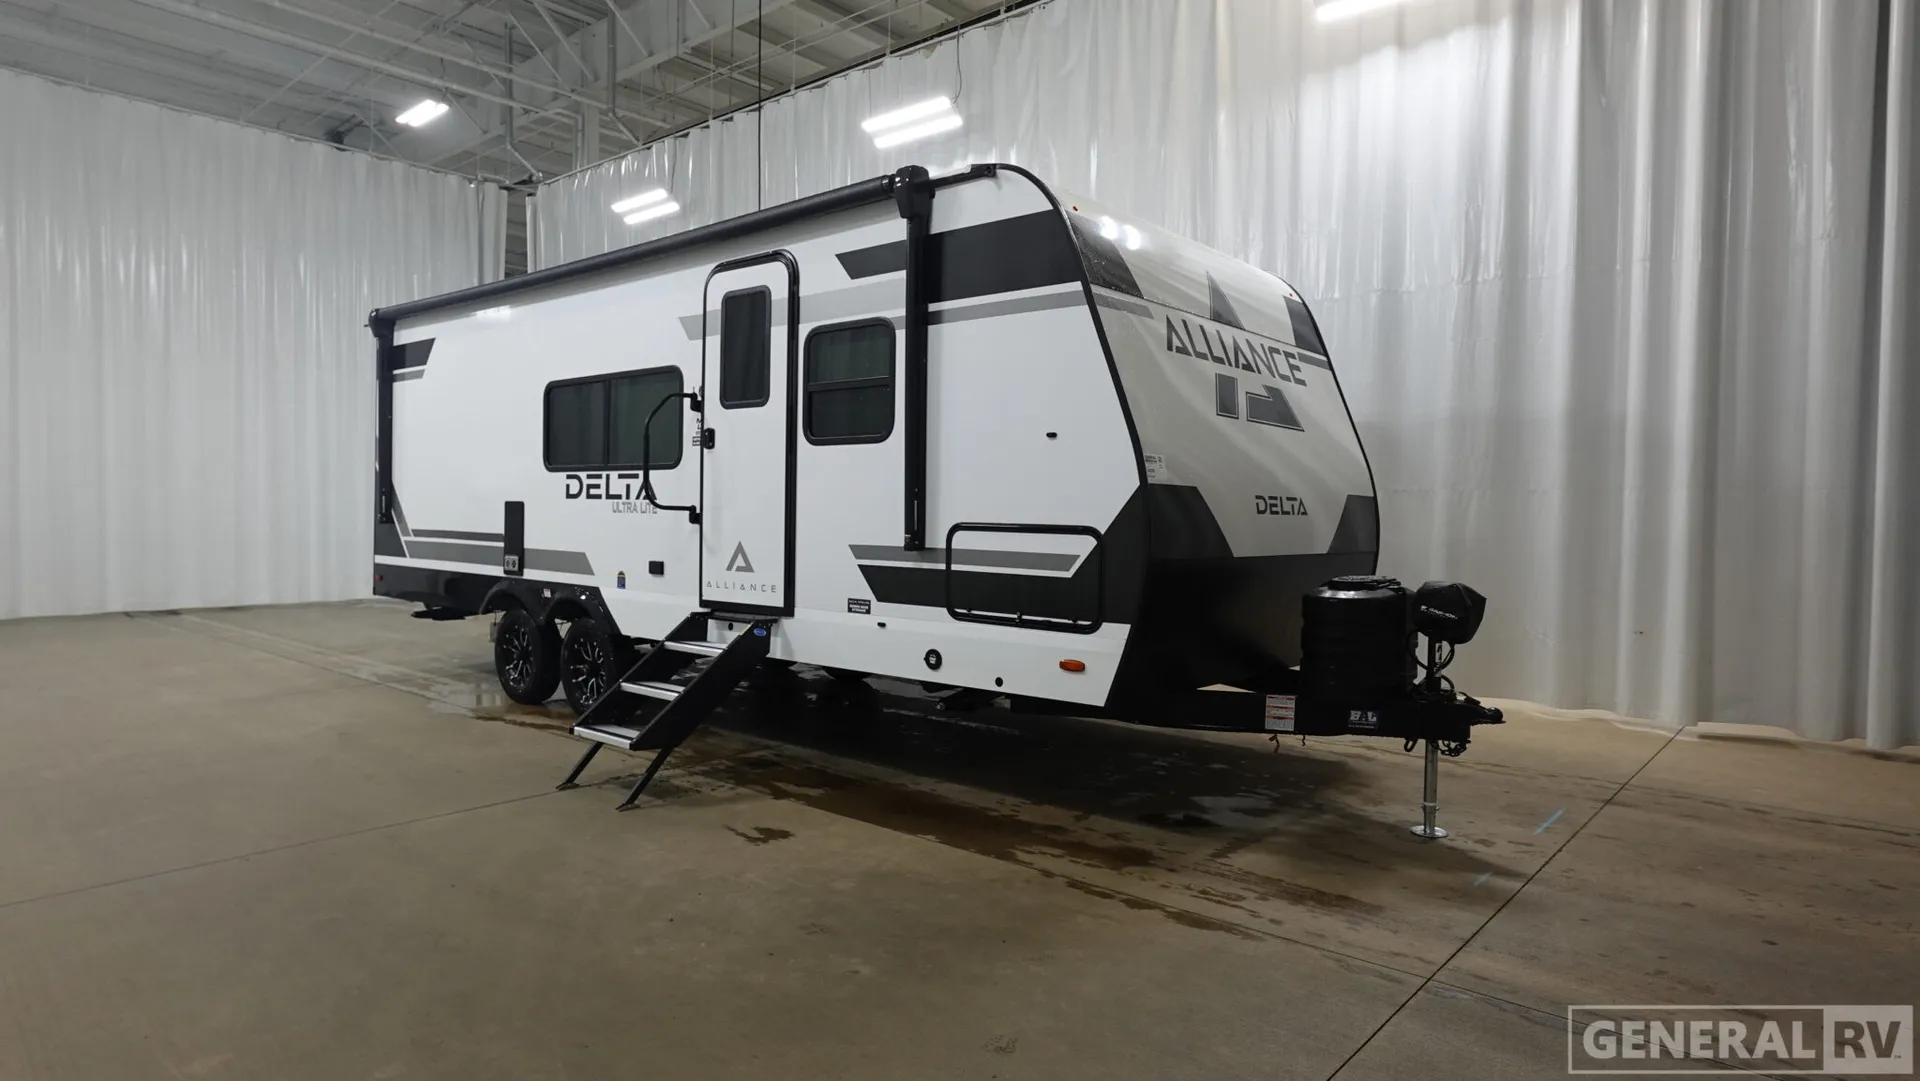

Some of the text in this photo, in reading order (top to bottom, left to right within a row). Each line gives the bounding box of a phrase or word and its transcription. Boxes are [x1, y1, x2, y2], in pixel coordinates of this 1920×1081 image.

[1167, 314, 1308, 386] ALLIANCE
[566, 473, 657, 501] DELTA
[612, 502, 638, 514] ULTRA
[1255, 495, 1308, 516] DELTA
[706, 580, 777, 593] ALLIANCE
